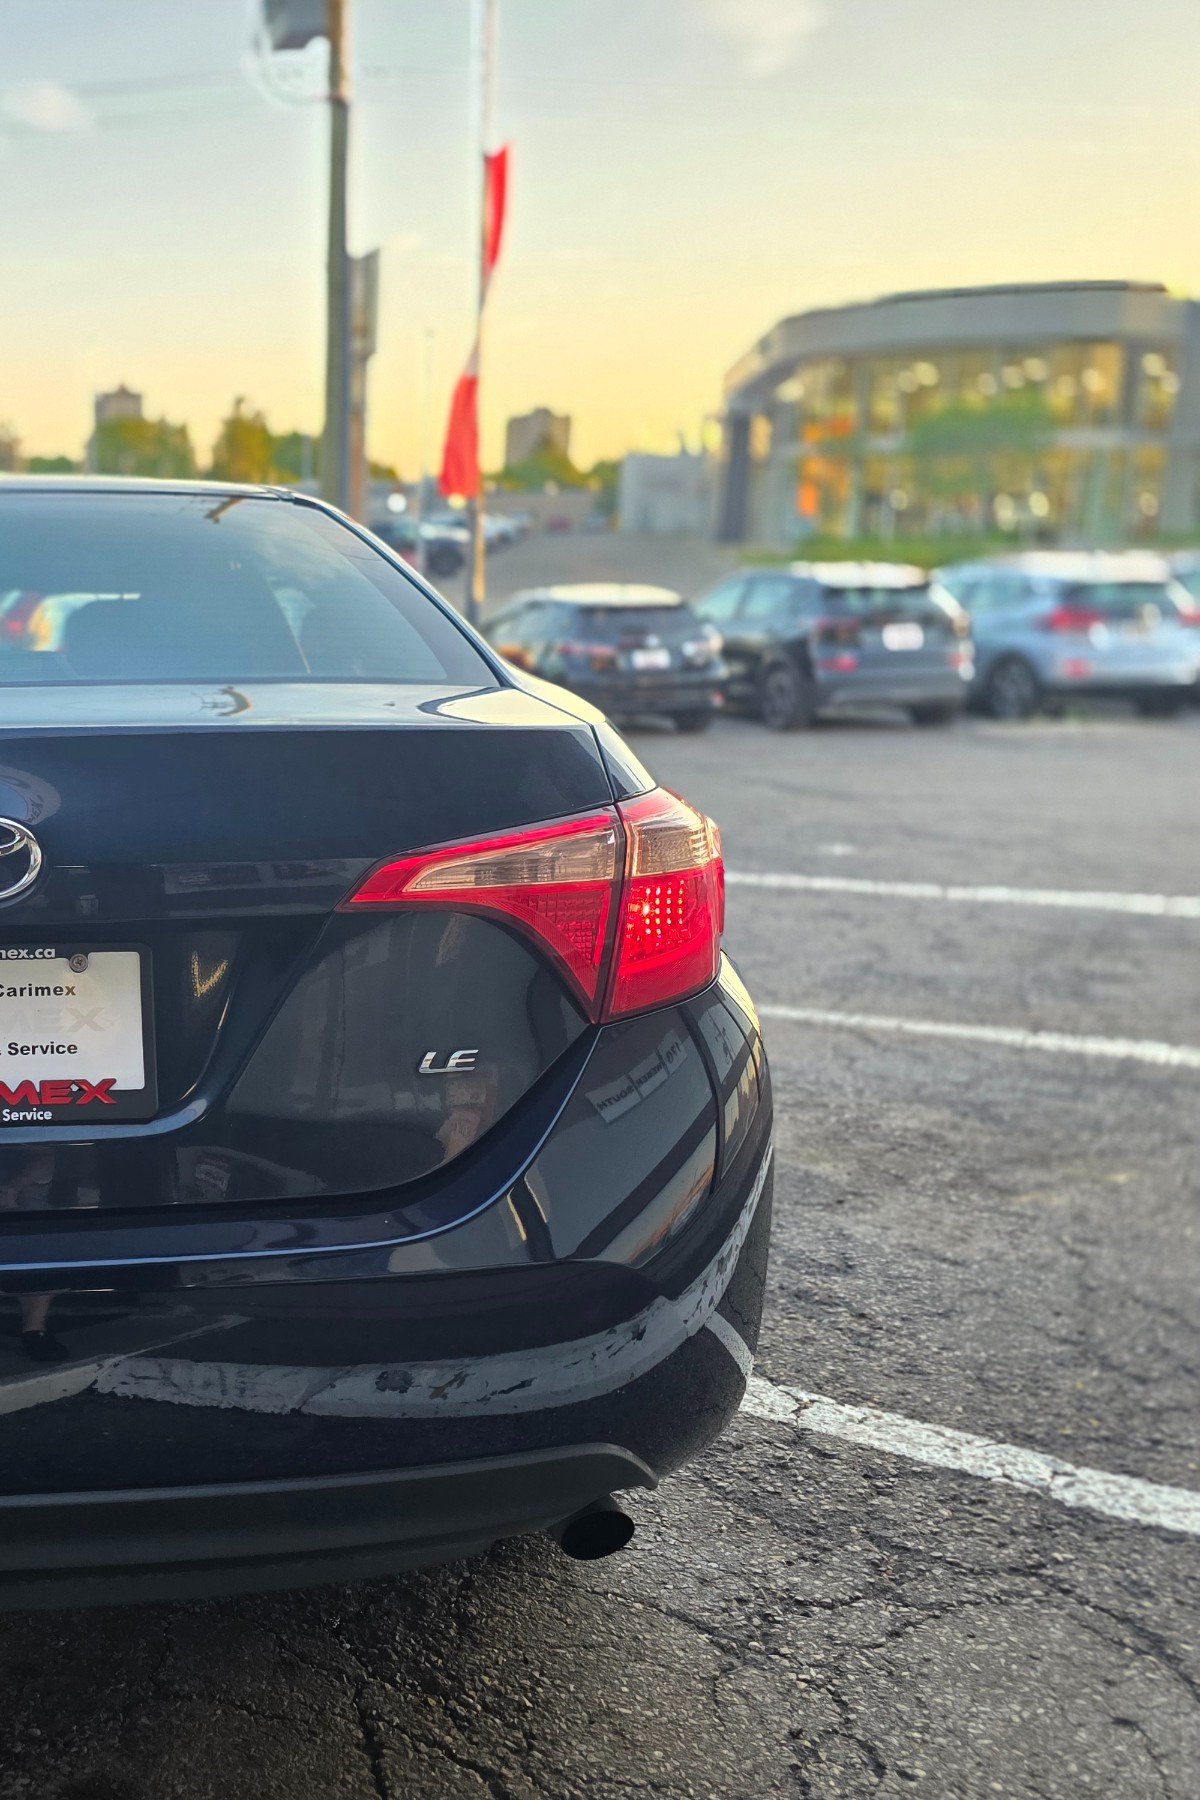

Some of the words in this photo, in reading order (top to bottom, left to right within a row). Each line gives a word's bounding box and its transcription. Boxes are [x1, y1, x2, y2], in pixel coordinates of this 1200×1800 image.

[7, 1041, 78, 1056] Service
[419, 1049, 479, 1073] LE
[2, 1108, 53, 1121] Service
